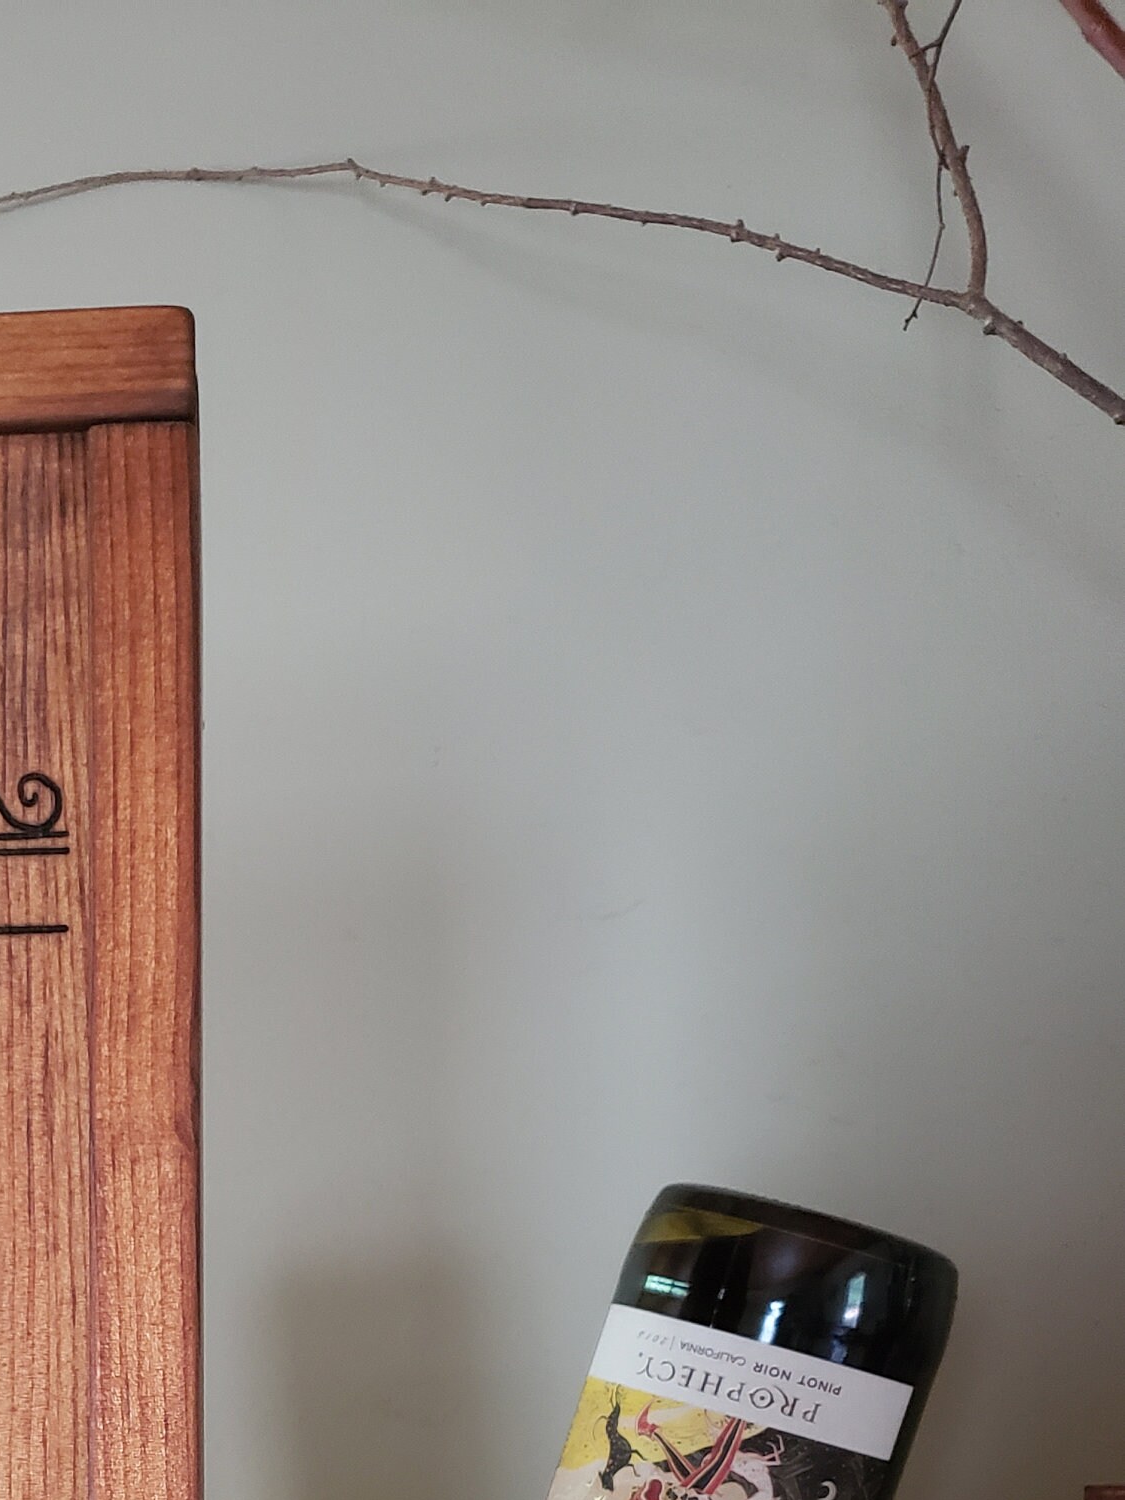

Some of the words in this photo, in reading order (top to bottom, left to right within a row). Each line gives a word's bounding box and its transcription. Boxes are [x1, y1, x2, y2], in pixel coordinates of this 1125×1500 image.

[679, 1341, 746, 1366] CALIFORNIA
[753, 1361, 792, 1381] NOIR
[797, 1374, 843, 1396] PINOT
